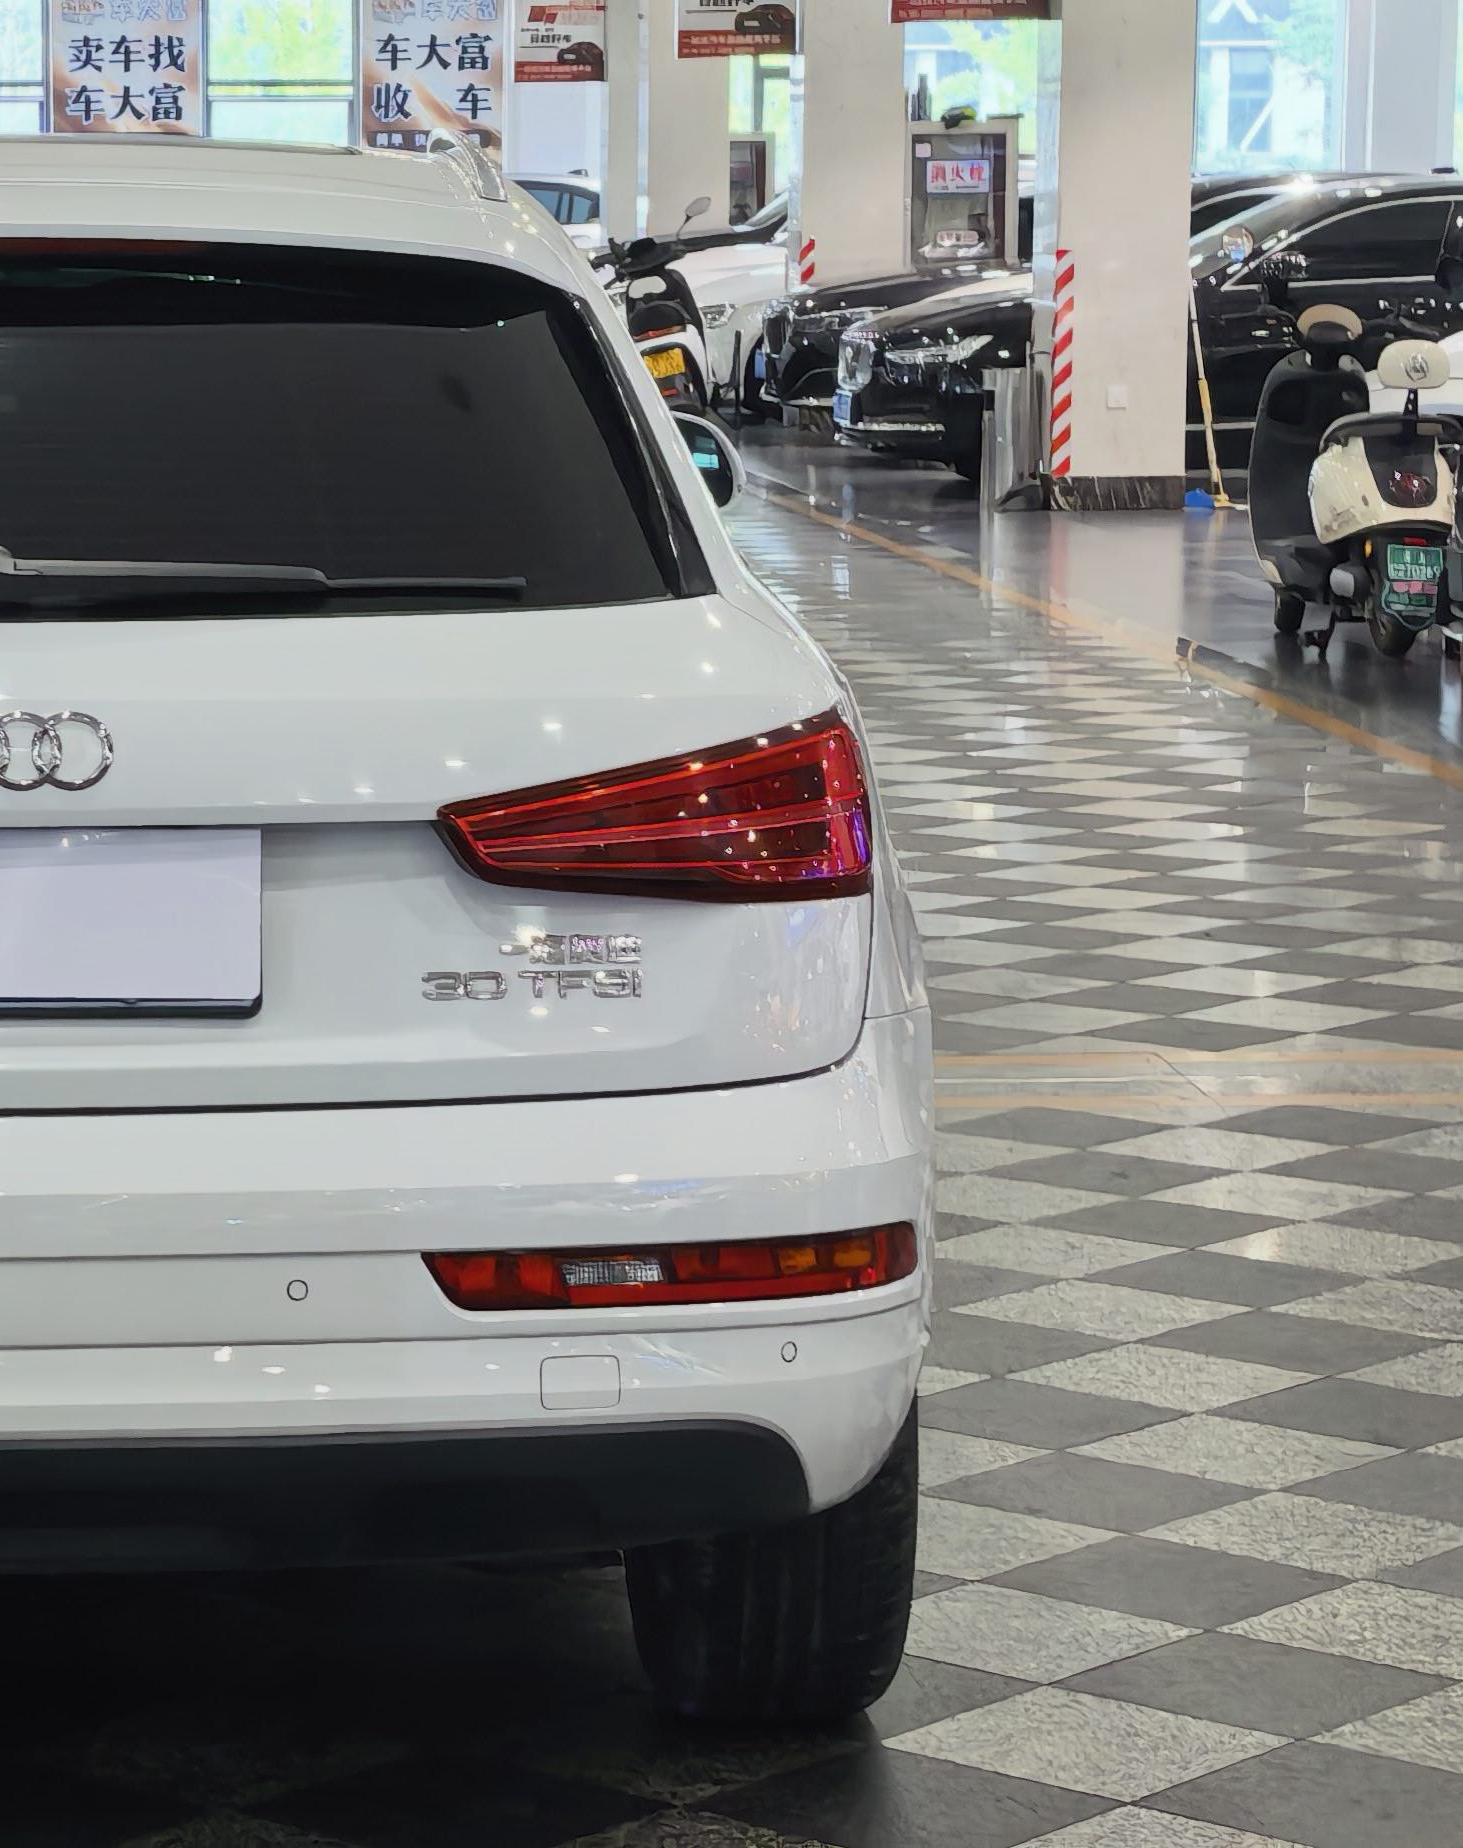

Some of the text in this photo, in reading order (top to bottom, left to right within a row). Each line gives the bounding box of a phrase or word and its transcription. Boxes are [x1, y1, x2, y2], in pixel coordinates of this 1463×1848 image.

[68, 34, 186, 73] 卖车找
[375, 32, 493, 72] 车大富
[68, 83, 186, 122] 车大富
[422, 969, 642, 1000] 30 TFSI
